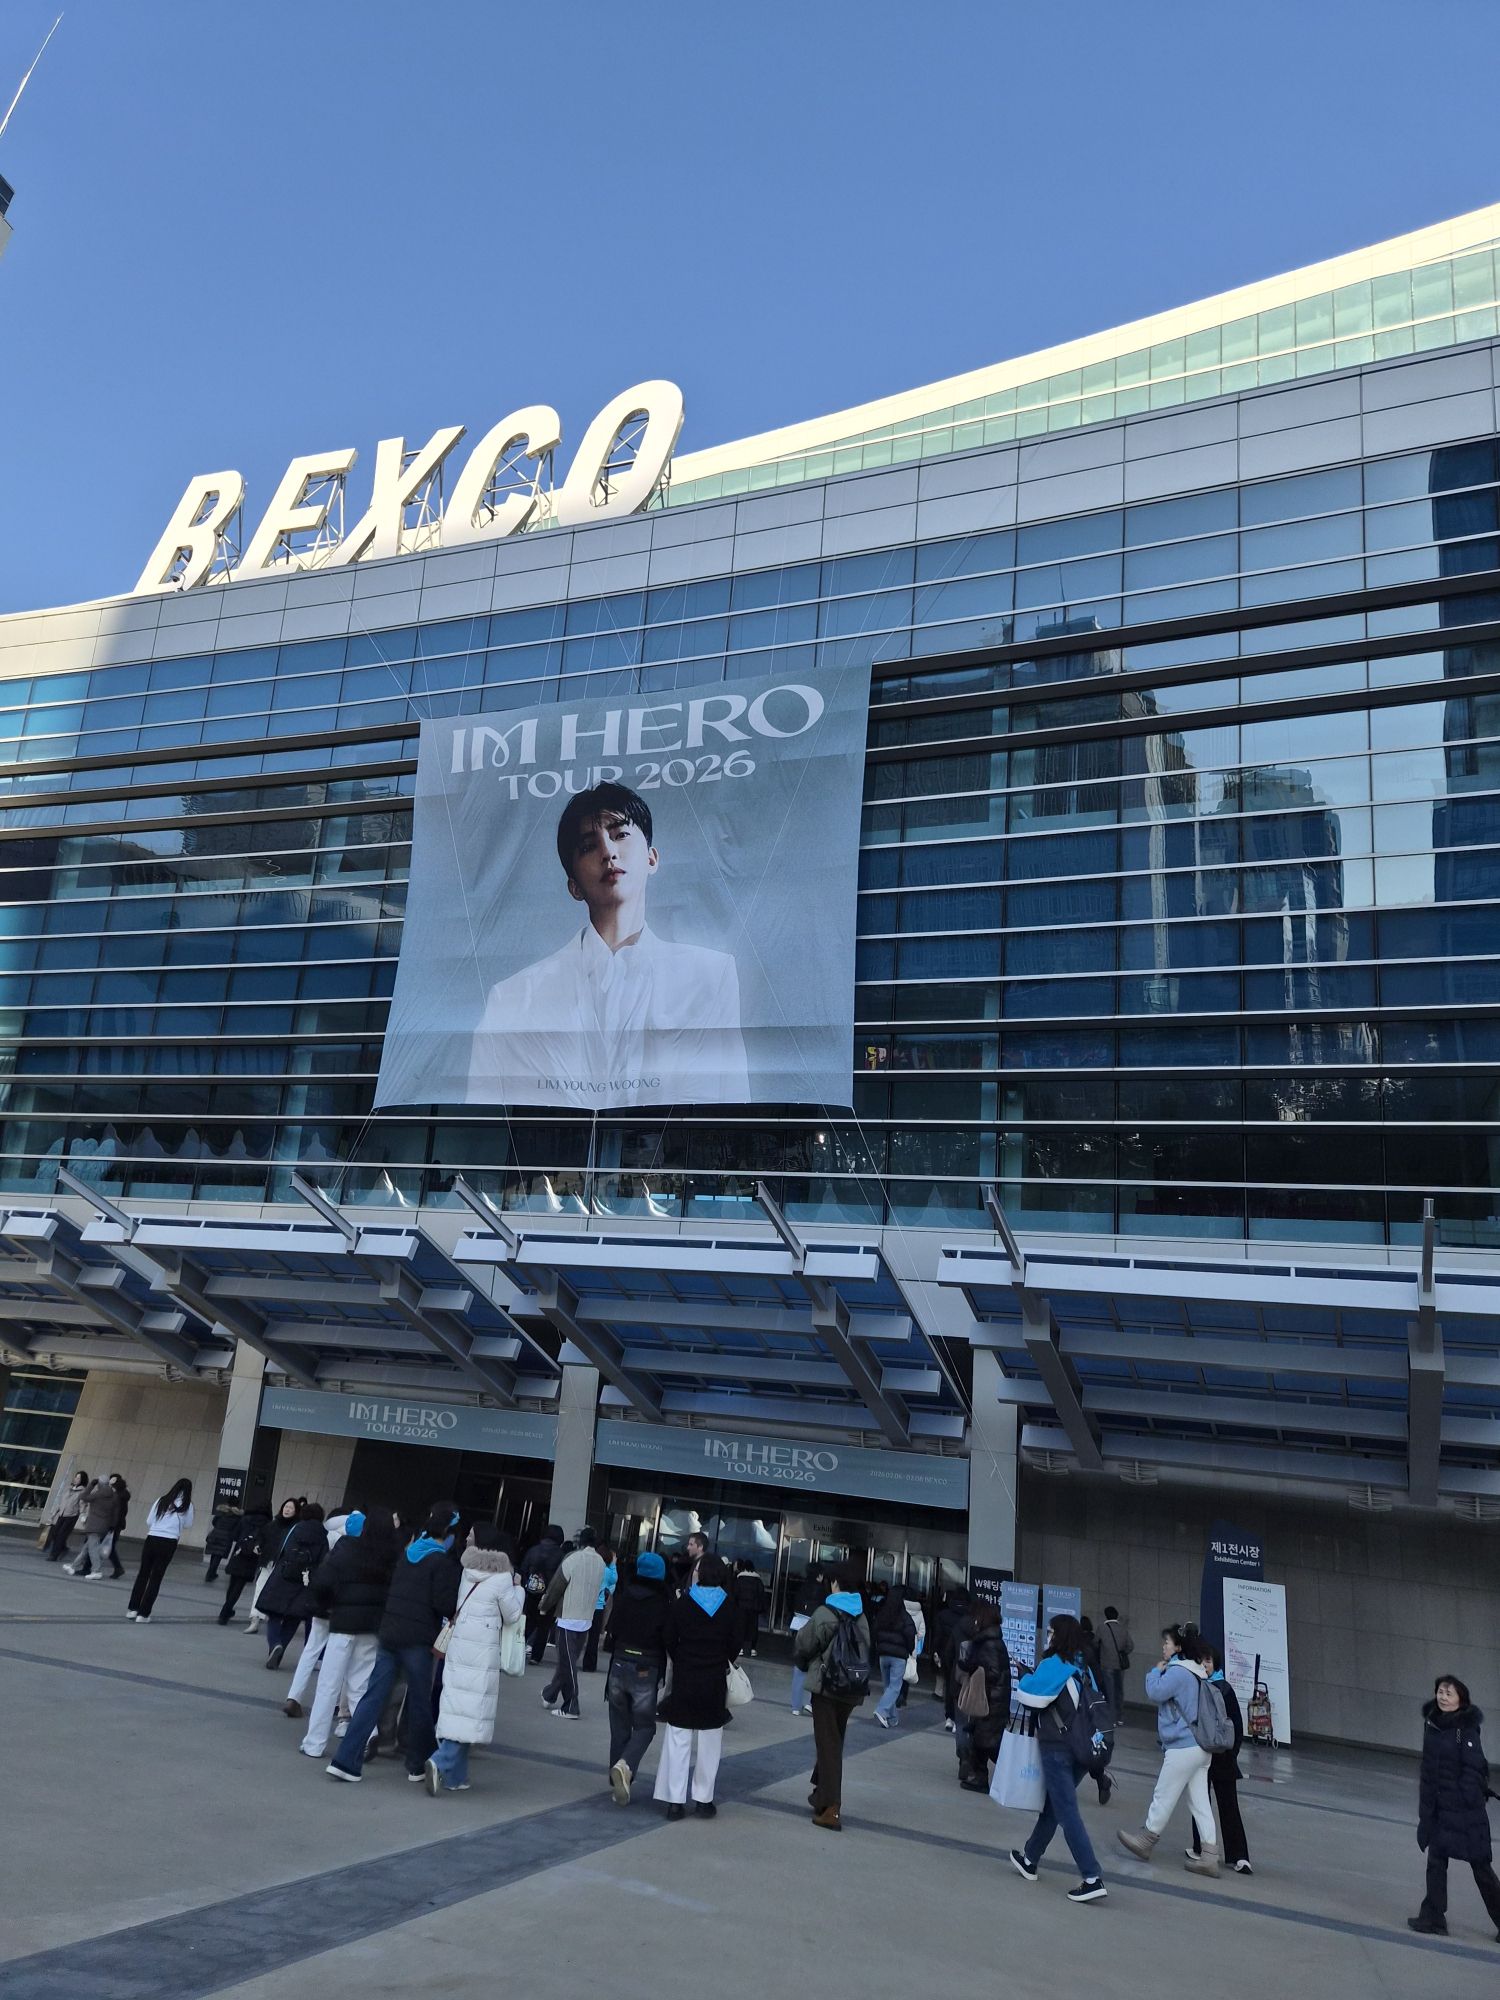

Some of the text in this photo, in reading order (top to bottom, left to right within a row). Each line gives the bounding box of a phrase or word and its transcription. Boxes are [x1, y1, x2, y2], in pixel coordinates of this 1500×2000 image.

[133, 379, 685, 592] BEXCO
[450, 684, 825, 774] IM HERO
[634, 749, 756, 790] 2026
[537, 1077, 661, 1093] LIM YOUNG WOONG
[348, 1402, 458, 1430] IM HERO
[364, 1422, 438, 1439] TOUR 2026
[703, 1438, 839, 1472] IM HERO
[723, 1461, 816, 1483] TOUR 2026
[1211, 1541, 1261, 1558] 제1전시장
[1214, 1555, 1240, 1564] Exhibition
[1240, 1559, 1257, 1567] Center
[974, 1577, 1002, 1591] W웨딩
[1237, 1583, 1272, 1594] INFORMATION
